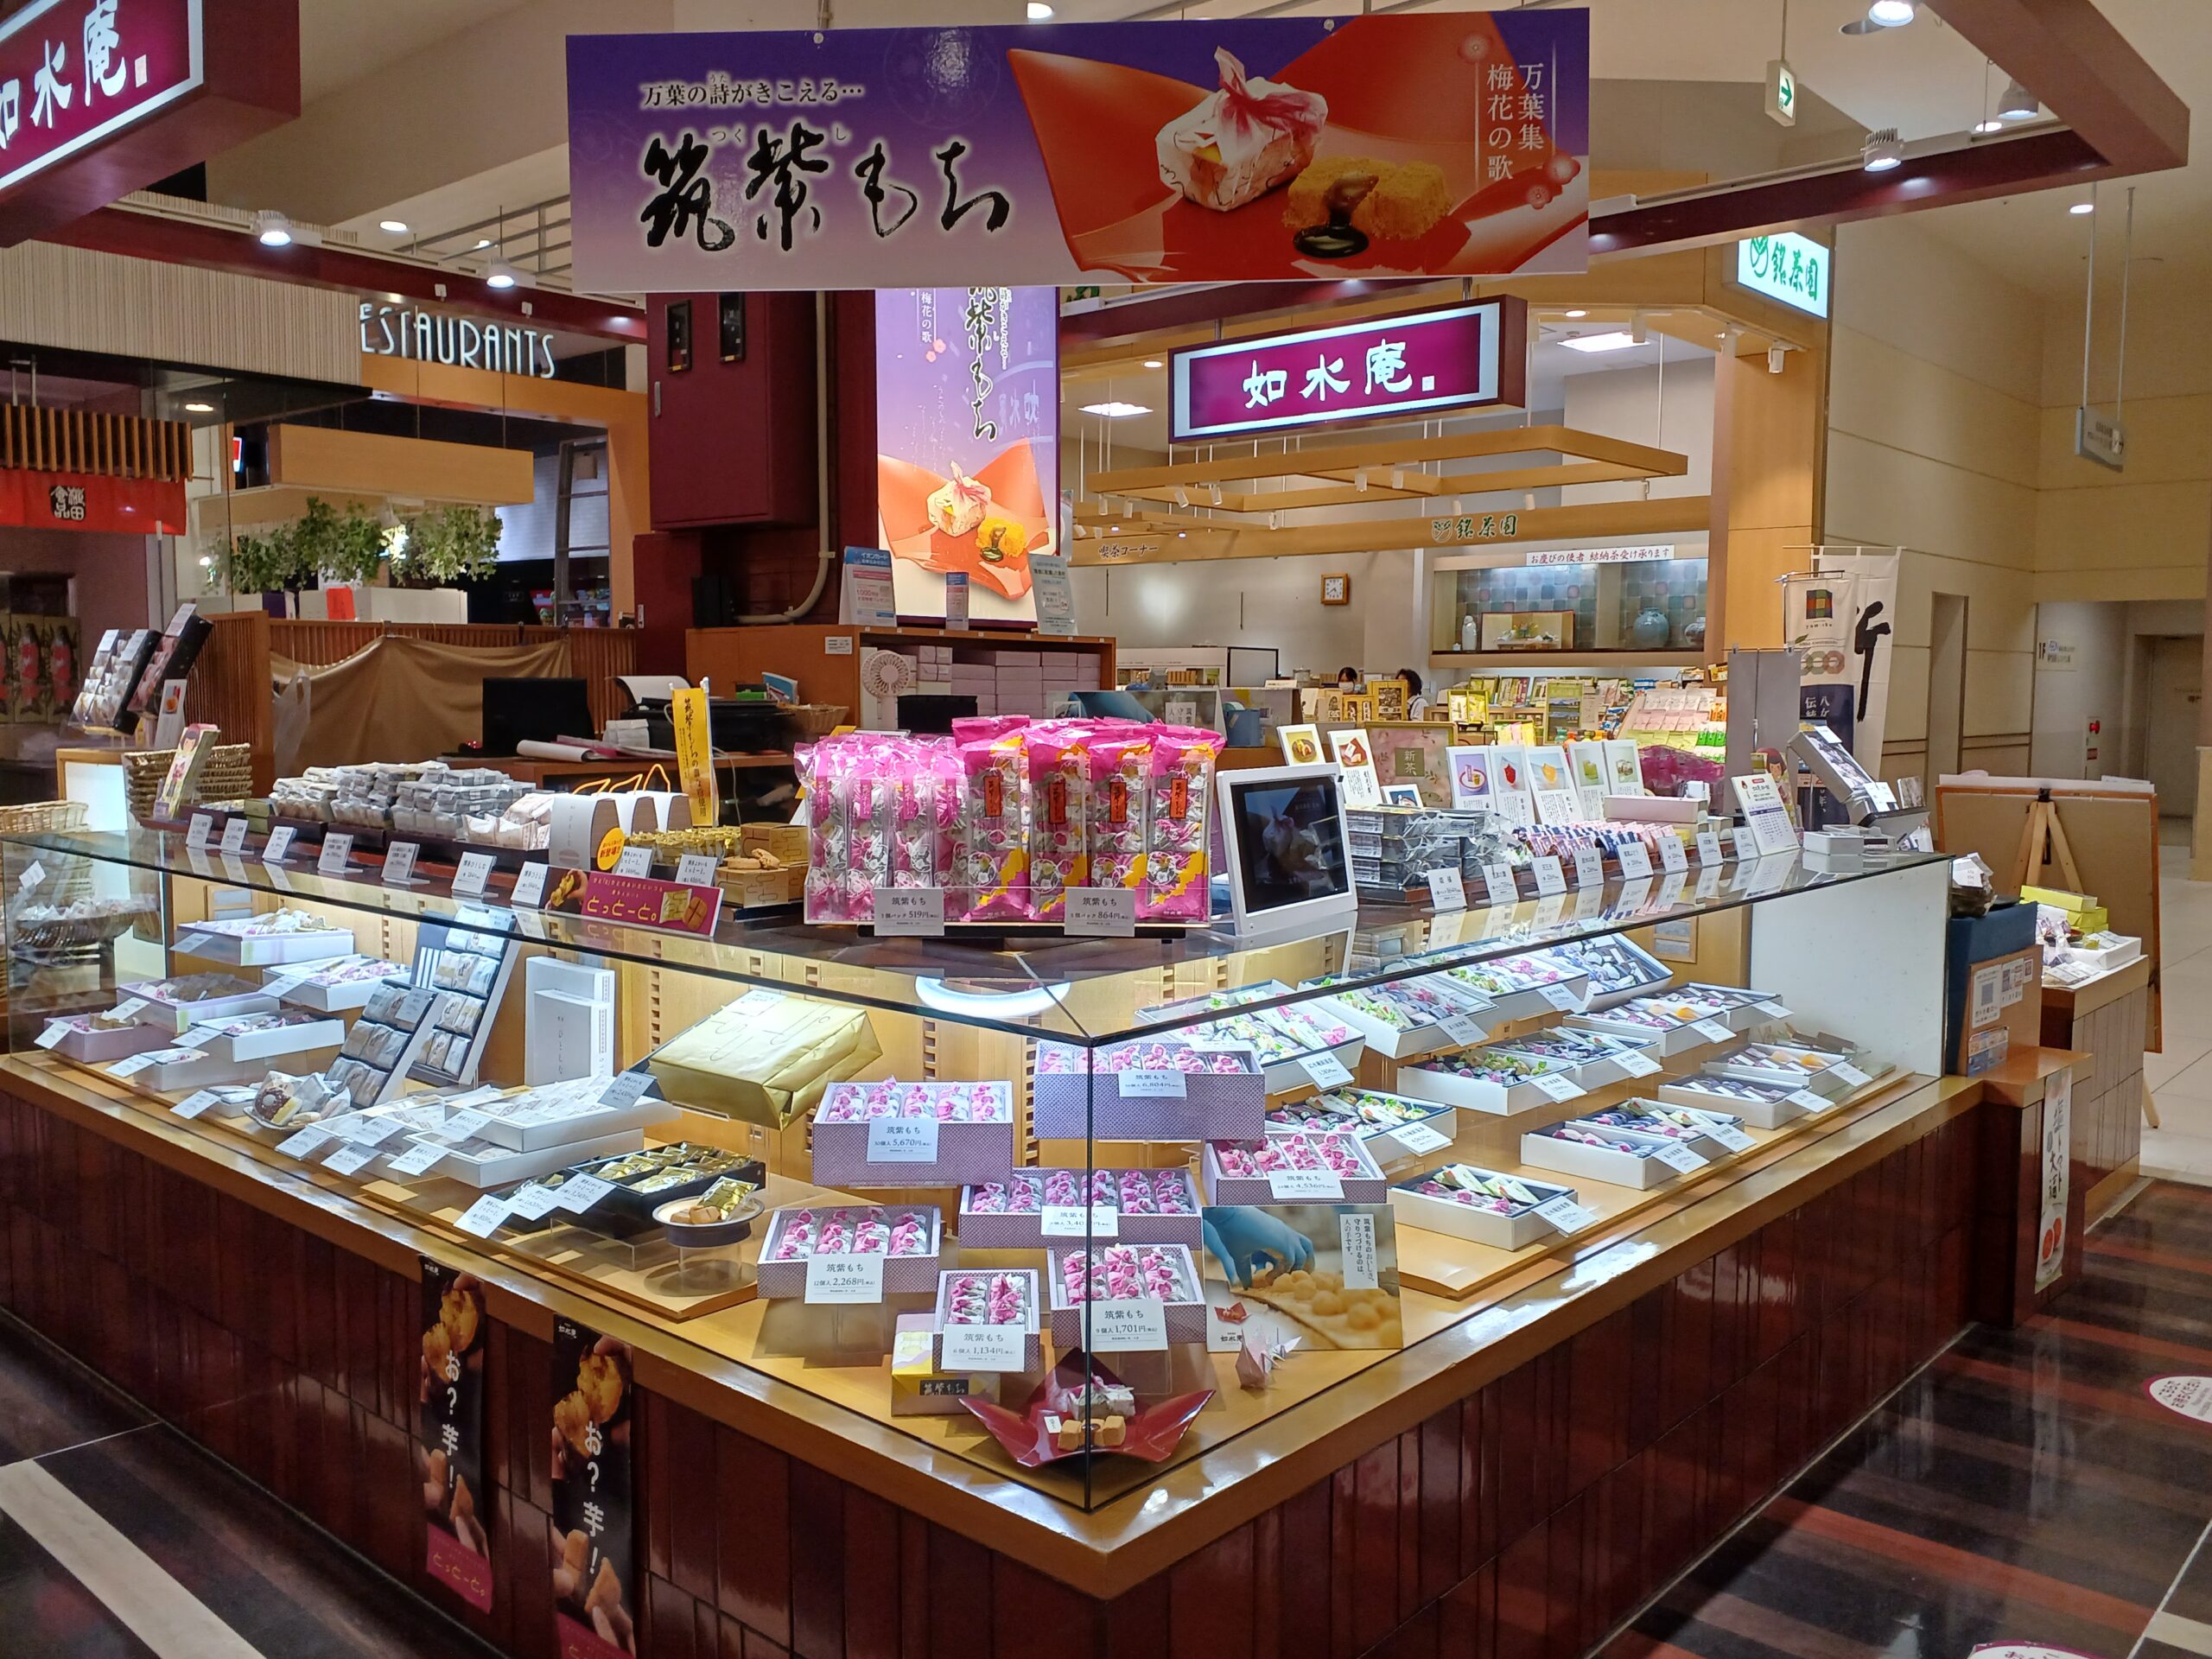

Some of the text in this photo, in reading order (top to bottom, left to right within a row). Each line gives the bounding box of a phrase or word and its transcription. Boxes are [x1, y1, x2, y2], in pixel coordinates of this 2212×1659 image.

[1518, 63, 1545, 151] 万葉集
[1487, 64, 1514, 181] 梅花の歌
[641, 123, 1010, 251] 筑紫もち
[921, 292, 932, 343] 梅花の歌
[1242, 340, 1414, 409] 如水庵
[1098, 544, 1158, 558] 喫茶コーナー
[1404, 750, 1417, 775] 新茶
[587, 895, 657, 921] とっとーと。
[891, 897, 926, 906] 筑紫もち
[1083, 897, 1117, 906] 筑紫もち
[887, 1126, 920, 1135] 筑紫もち
[826, 1263, 864, 1273] 筑紫もち
[1104, 1310, 1144, 1319] 筑紫もち
[963, 1333, 1004, 1342] 筑紫もち
